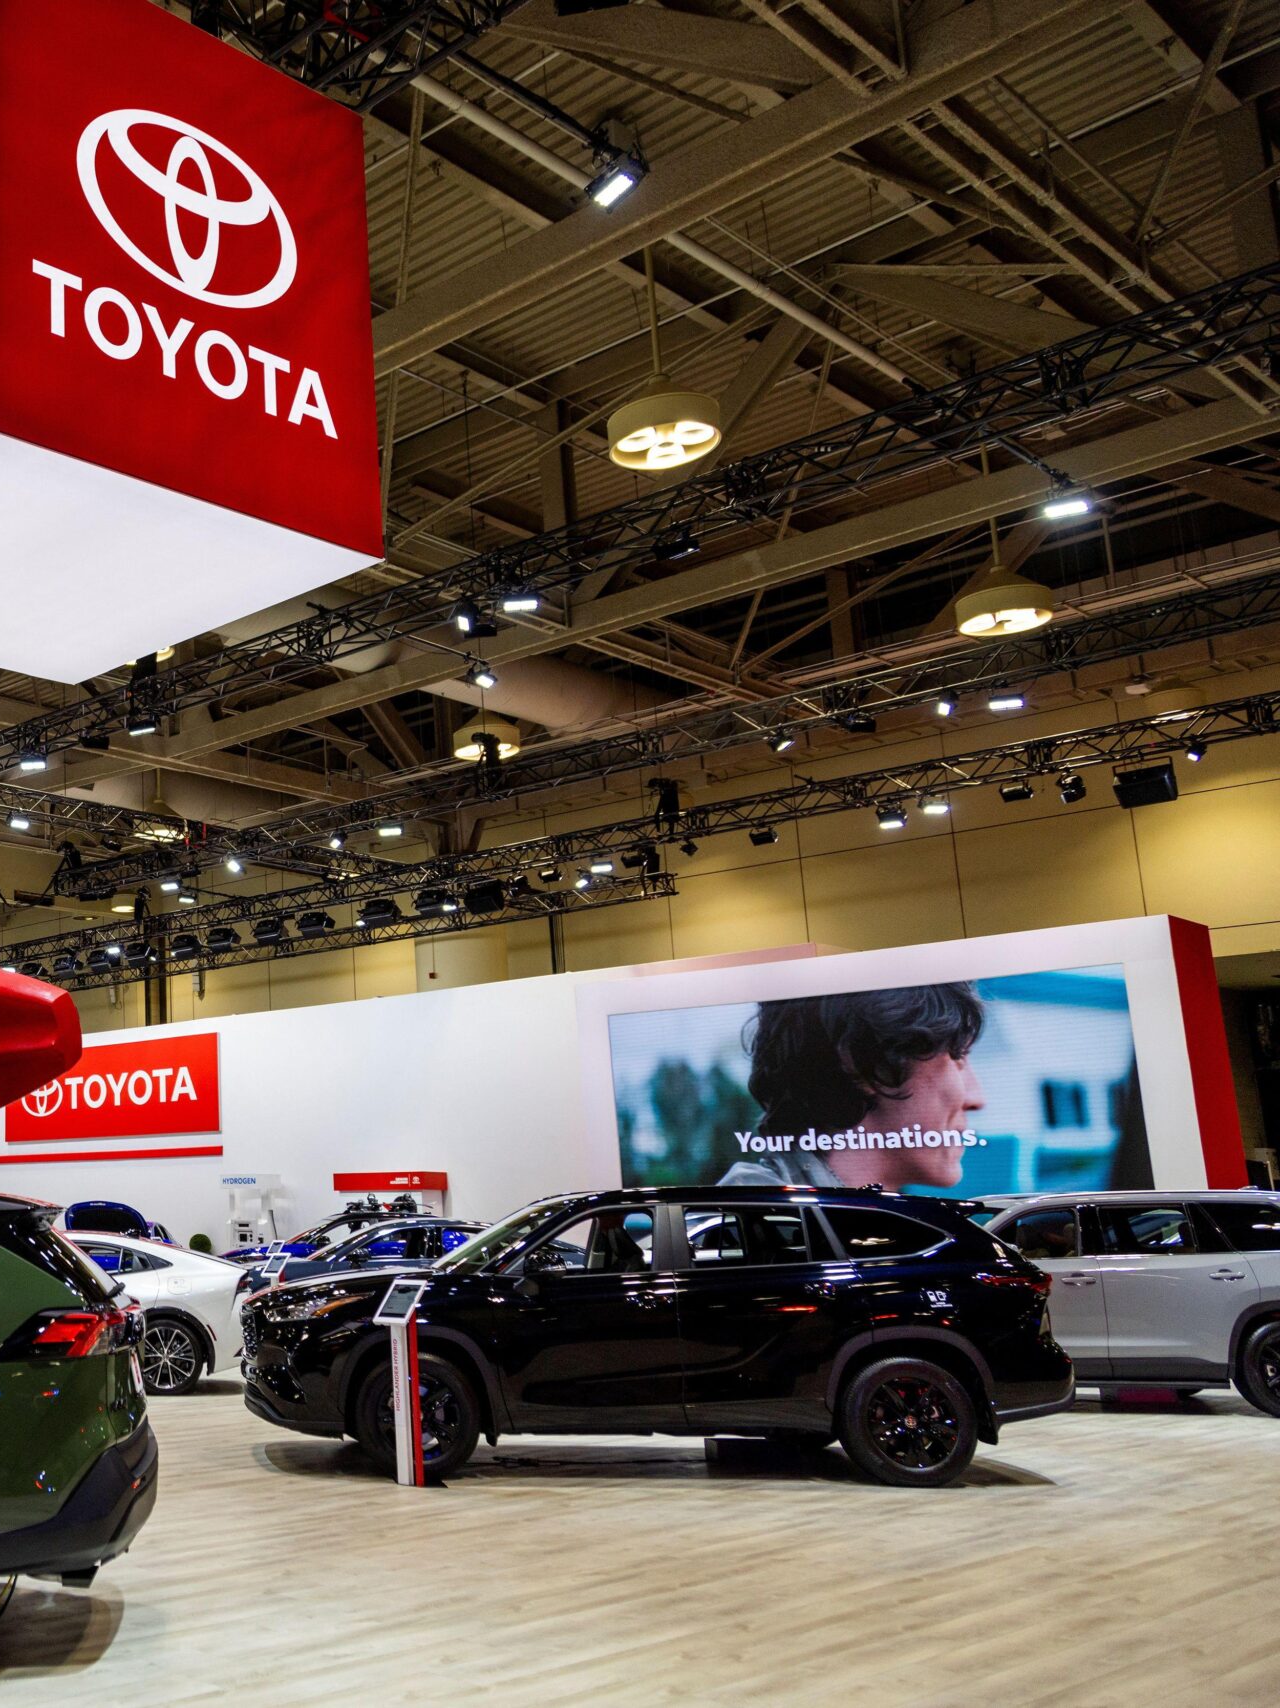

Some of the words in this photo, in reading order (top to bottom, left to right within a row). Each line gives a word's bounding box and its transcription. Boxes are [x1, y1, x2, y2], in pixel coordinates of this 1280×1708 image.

[32, 259, 339, 440] TOYOTA
[65, 1066, 197, 1109] TOYOTA
[734, 1131, 794, 1153] Your
[799, 1124, 987, 1151] destinations.
